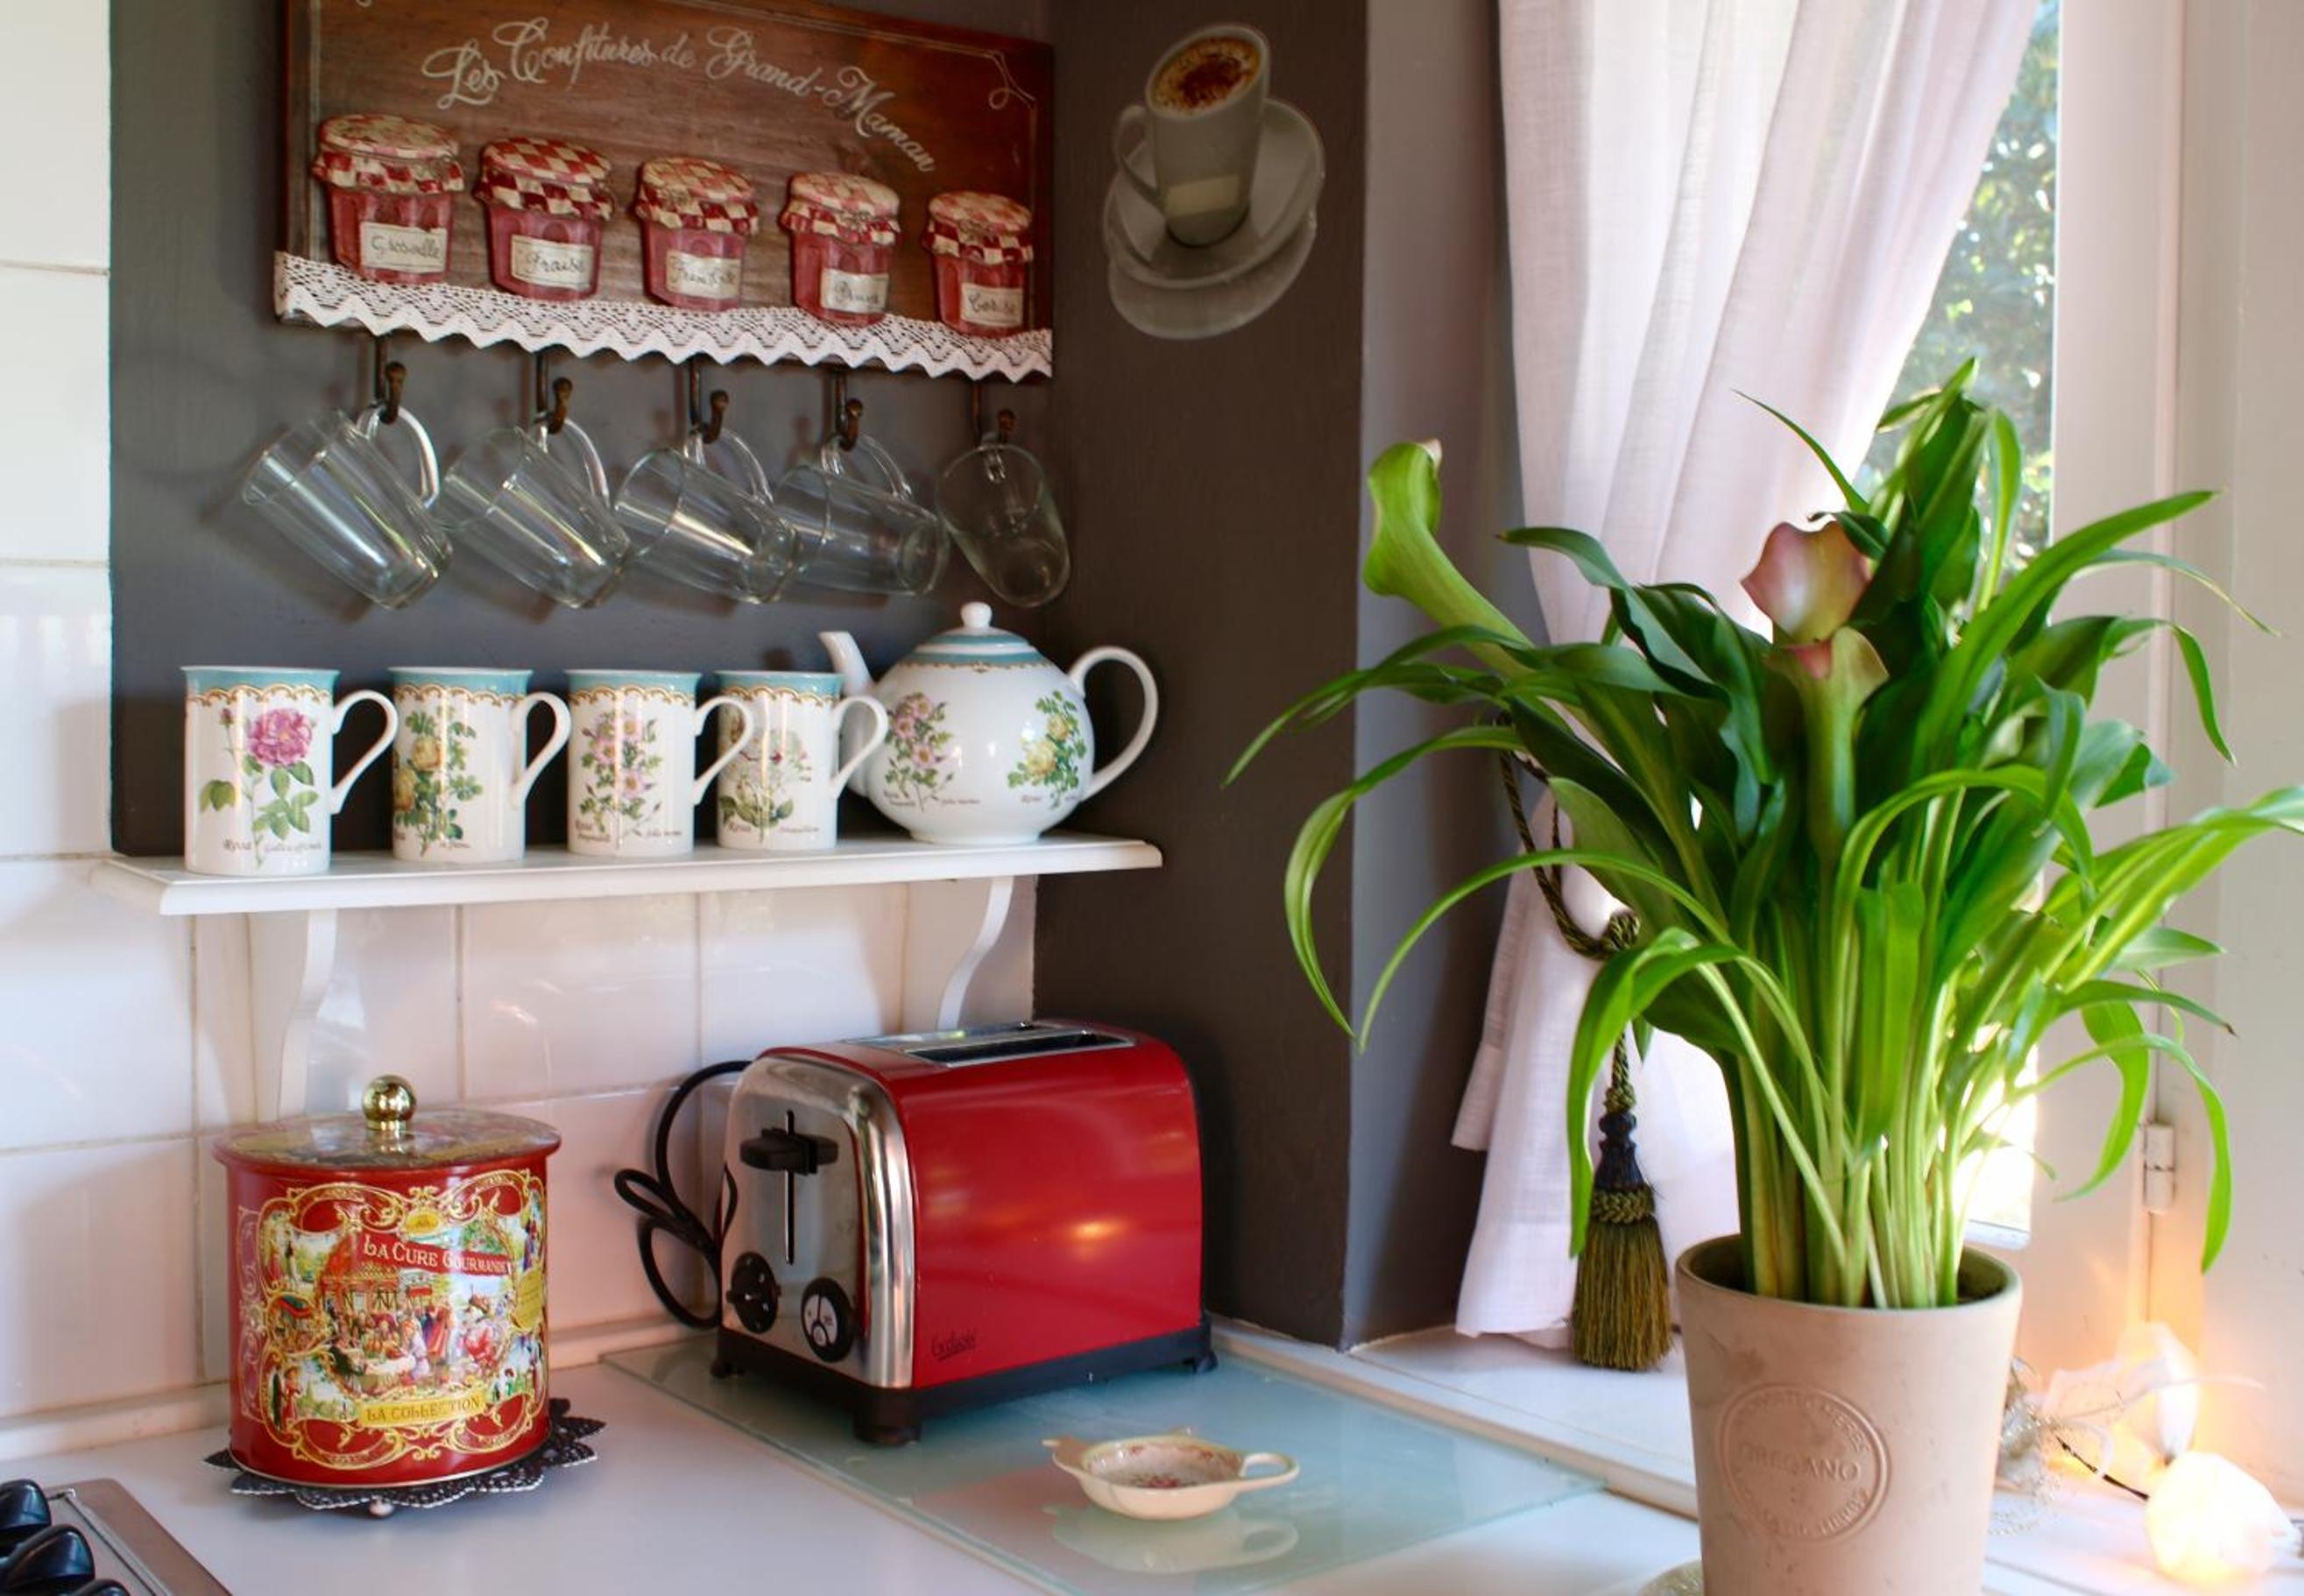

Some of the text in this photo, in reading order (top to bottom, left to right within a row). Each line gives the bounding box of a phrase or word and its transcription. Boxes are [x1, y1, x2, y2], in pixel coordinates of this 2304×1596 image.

[421, 39, 505, 109] Les
[492, 17, 658, 85] Confitures
[660, 33, 696, 69] de
[392, 1241, 437, 1268] CURE
